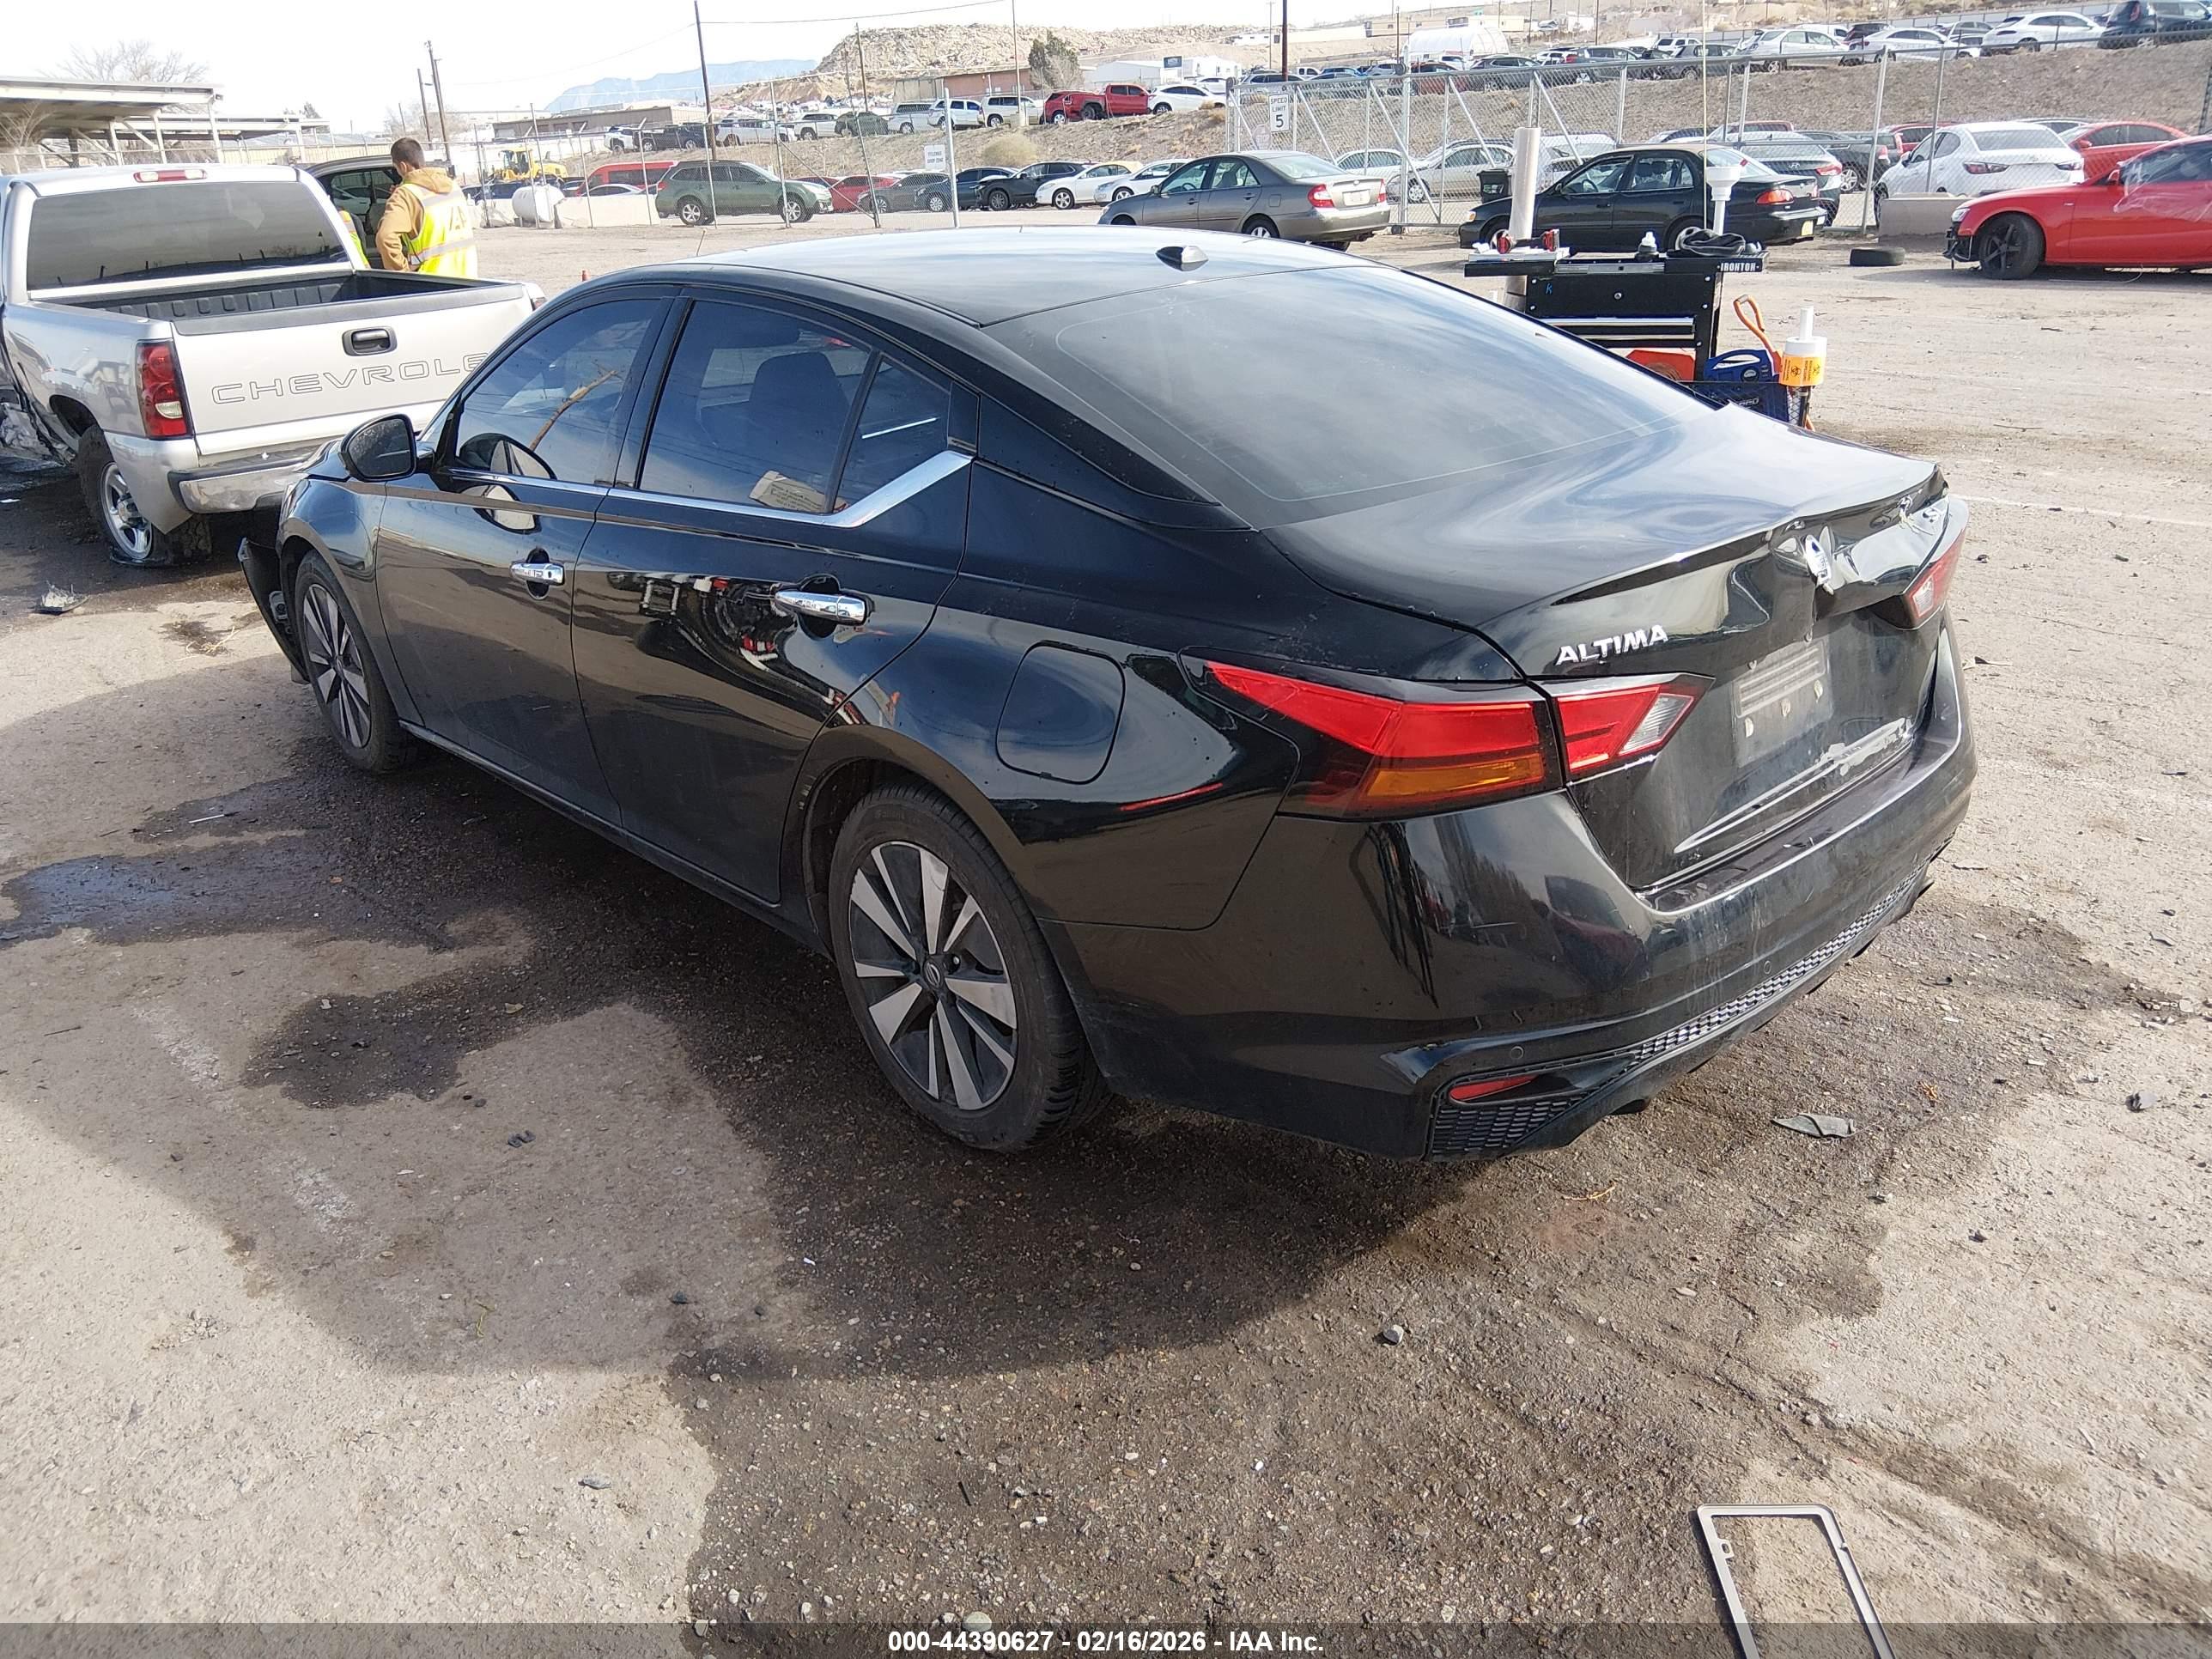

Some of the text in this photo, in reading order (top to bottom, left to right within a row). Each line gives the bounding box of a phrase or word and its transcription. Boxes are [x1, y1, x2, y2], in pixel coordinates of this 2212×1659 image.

[1276, 114, 1284, 128] 5
[1720, 262, 1757, 272] IRONTON
[211, 351, 488, 405] CHEVROLE
[1555, 623, 1669, 666] ALTIMA
